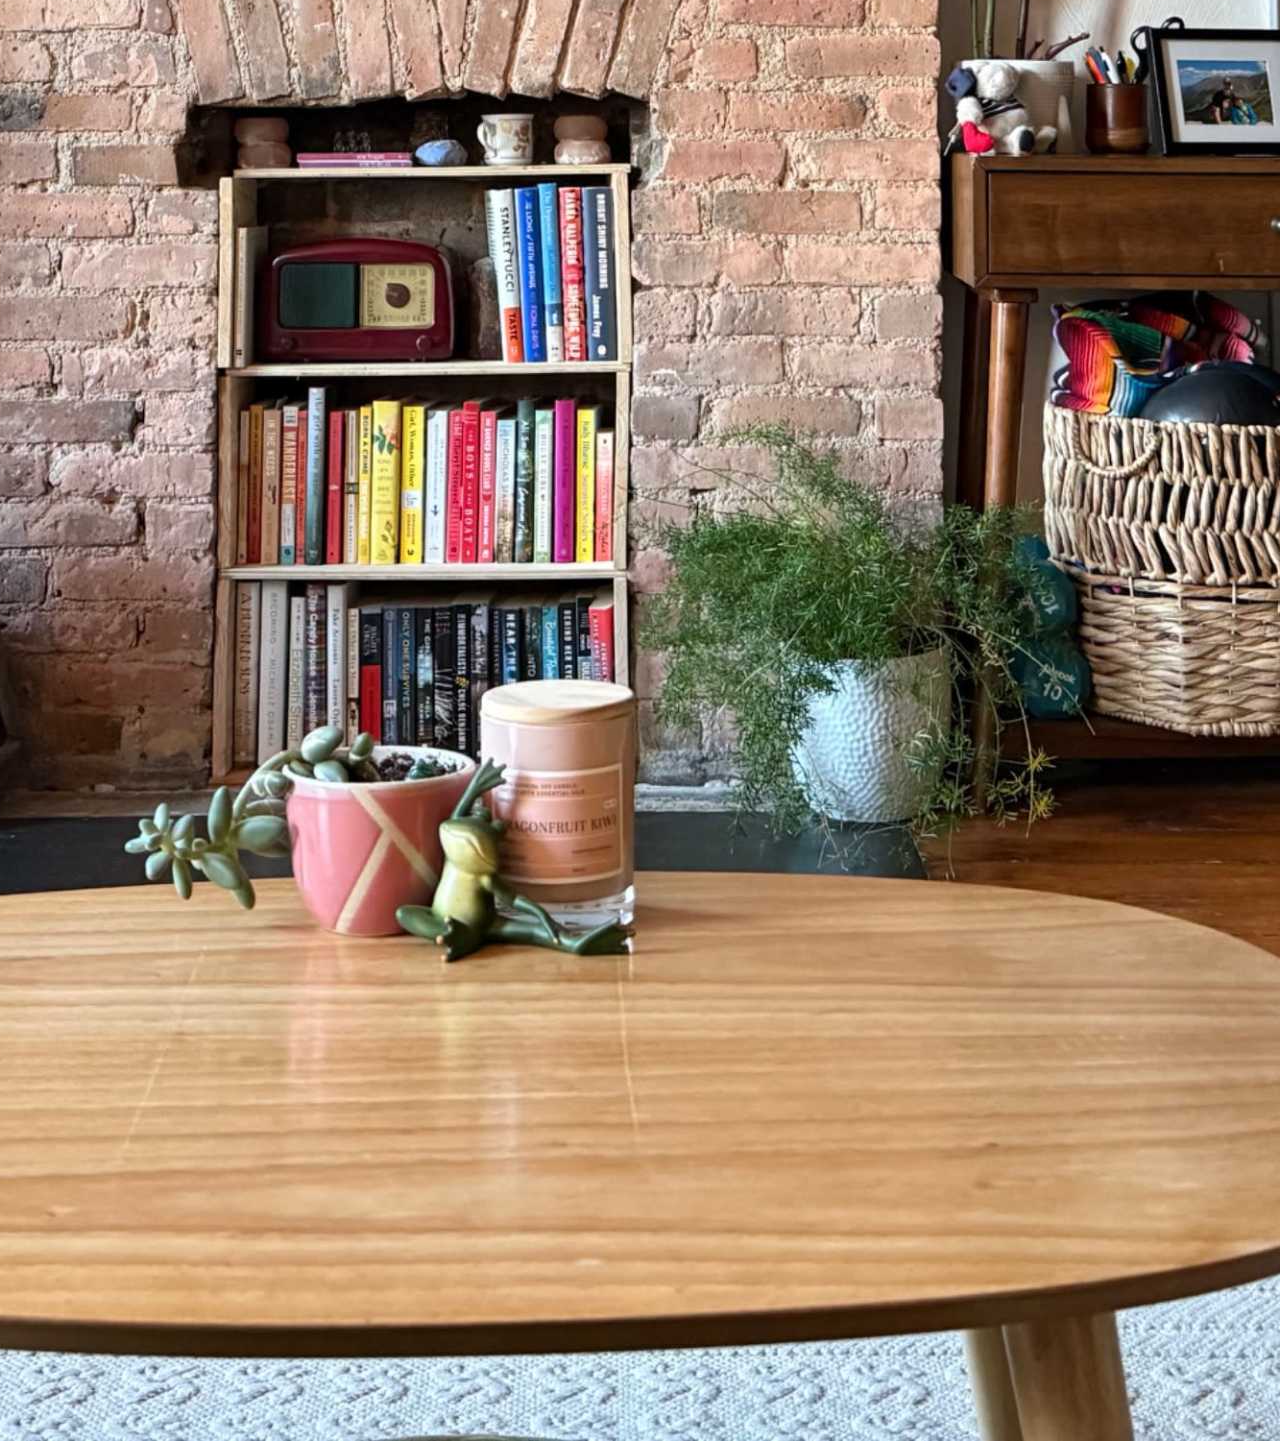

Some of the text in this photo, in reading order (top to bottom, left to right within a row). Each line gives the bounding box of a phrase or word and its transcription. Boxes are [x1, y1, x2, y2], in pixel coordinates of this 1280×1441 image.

[500, 207, 515, 292] STANLEY TUCCI
[597, 224, 608, 248] SHINY
[598, 251, 608, 288] MORNING
[508, 312, 518, 340] TASTE
[592, 294, 602, 338] James Frey
[284, 431, 296, 498] WANDERLUST
[464, 445, 475, 544] BOYS BOAT
[1039, 594, 1060, 615] 10
[308, 613, 317, 643] Candy
[402, 612, 410, 635] ONLY
[506, 614, 516, 671] NEAR THE
[563, 609, 572, 680] BEHIND HER EYE
[309, 646, 317, 676] House
[289, 648, 302, 742] Elizabeth Strout
[1042, 682, 1063, 701] 10
[505, 817, 588, 834] RAGONFRUIT
